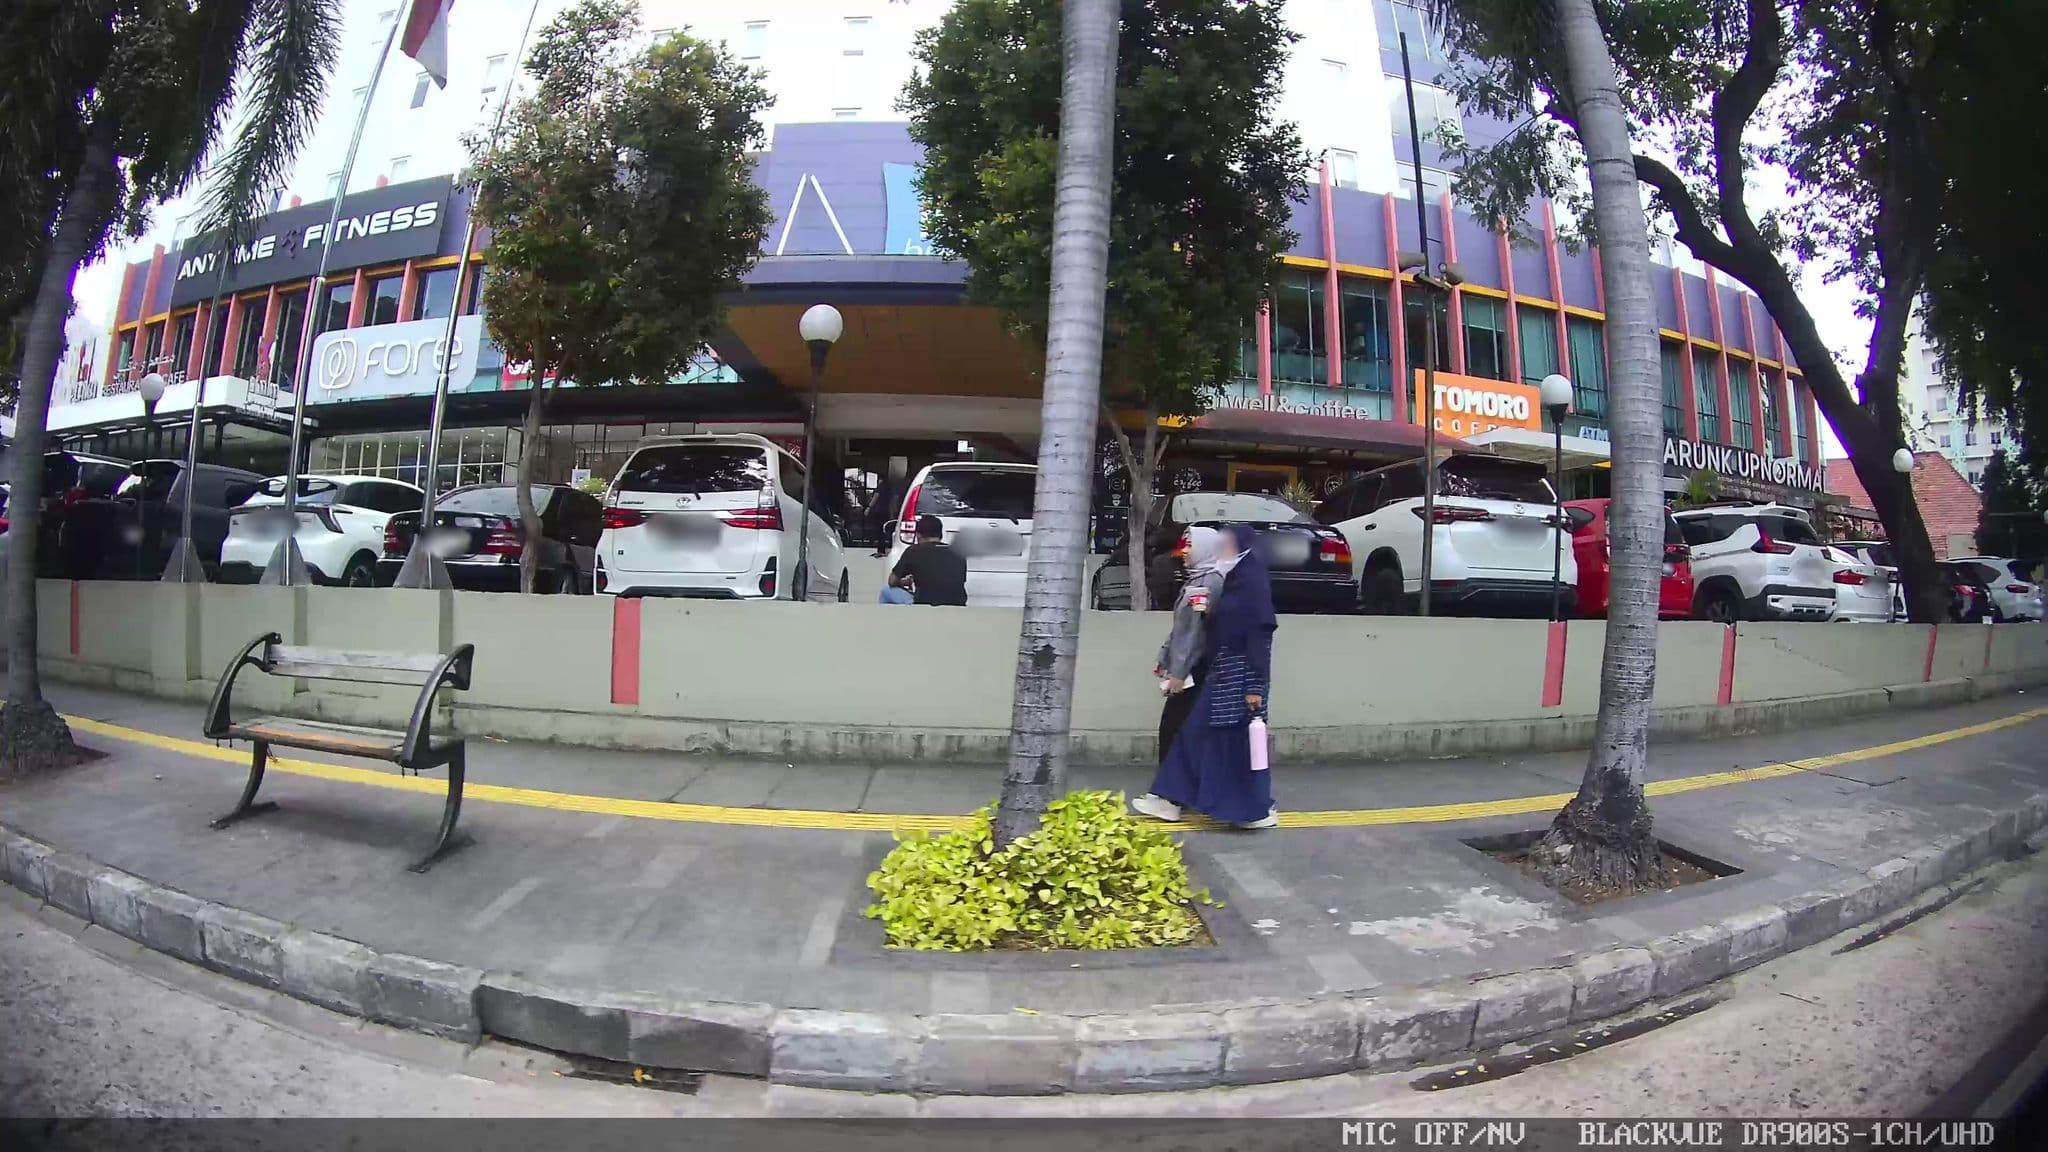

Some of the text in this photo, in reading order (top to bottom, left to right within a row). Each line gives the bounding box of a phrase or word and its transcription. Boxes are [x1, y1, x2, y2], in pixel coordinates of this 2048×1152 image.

[178, 201, 439, 280] ANYIME FITNESS
[1433, 384, 1530, 421] TOMORO
[1434, 416, 1526, 434] COF
